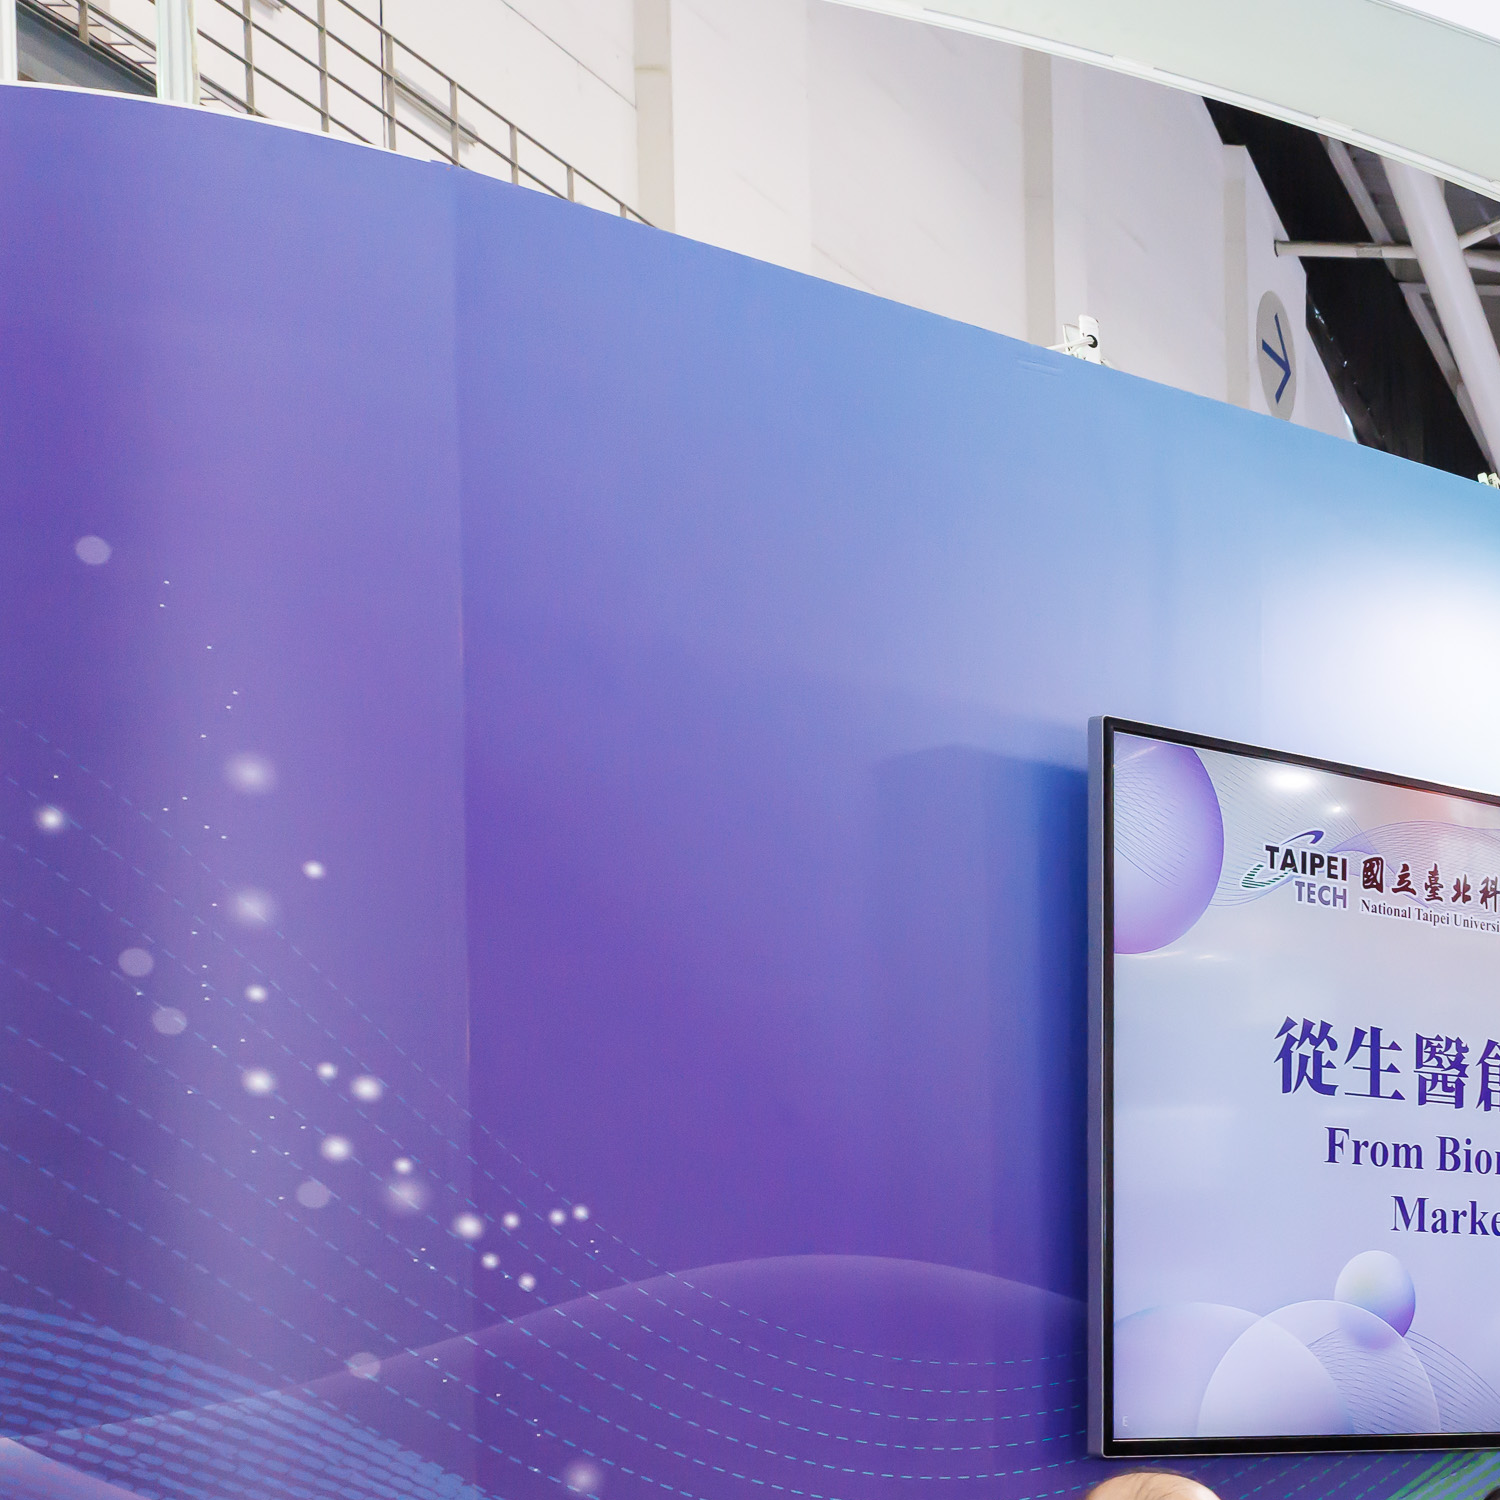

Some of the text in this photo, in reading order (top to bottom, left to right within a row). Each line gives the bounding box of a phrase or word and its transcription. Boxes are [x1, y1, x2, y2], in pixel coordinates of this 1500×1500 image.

[1264, 846, 1347, 882] TAIPEI
[1294, 880, 1347, 909] TECH
[1361, 899, 1412, 920] National
[1415, 907, 1450, 927] Taipei
[1324, 1126, 1424, 1170] From
